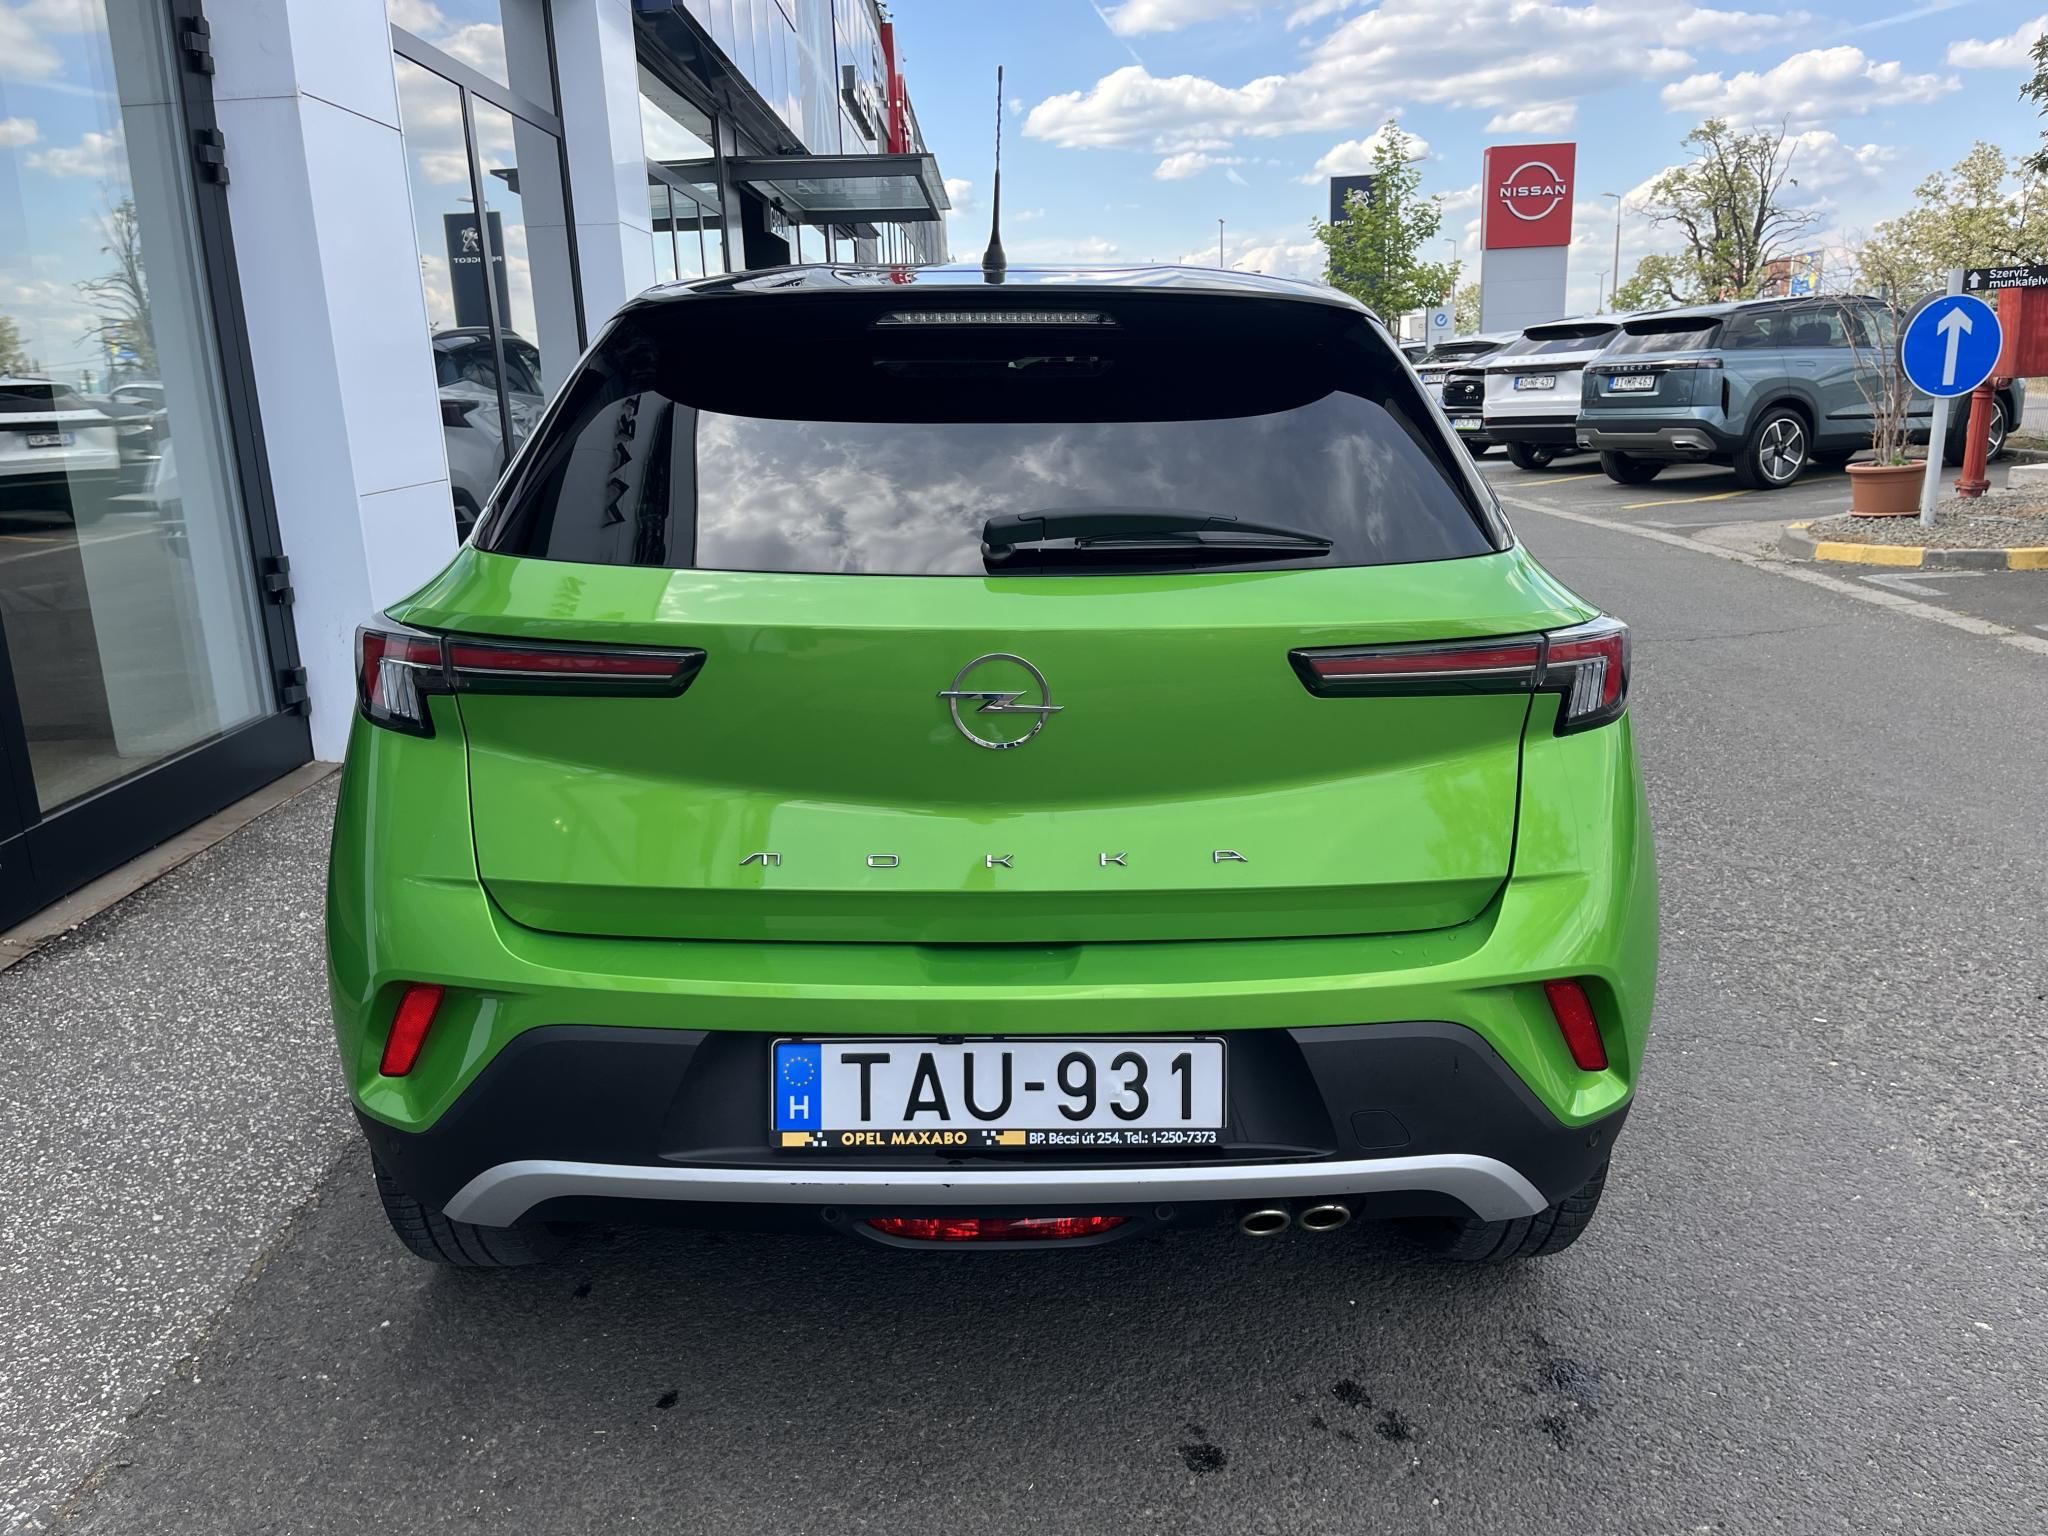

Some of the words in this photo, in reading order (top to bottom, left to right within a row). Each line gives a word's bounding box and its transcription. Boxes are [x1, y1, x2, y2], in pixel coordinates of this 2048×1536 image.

[1500, 185, 1566, 197] NISSAN
[1989, 267, 2029, 279] Szerviz
[1989, 276, 2048, 288] munkafelv
[739, 849, 1248, 868] MOKKA
[841, 1051, 1192, 1121] TAU-931
[789, 1095, 809, 1119] H
[841, 1132, 885, 1145] OPEL
[891, 1131, 967, 1145] MAXABO
[1029, 1133, 1046, 1144] BP.
[1049, 1131, 1079, 1145] Bécsi
[1082, 1132, 1098, 1145] út
[1099, 1133, 1122, 1144] 254.
[1125, 1132, 1148, 1144] Tel.:
[1151, 1132, 1217, 1145] 1-250-7373
